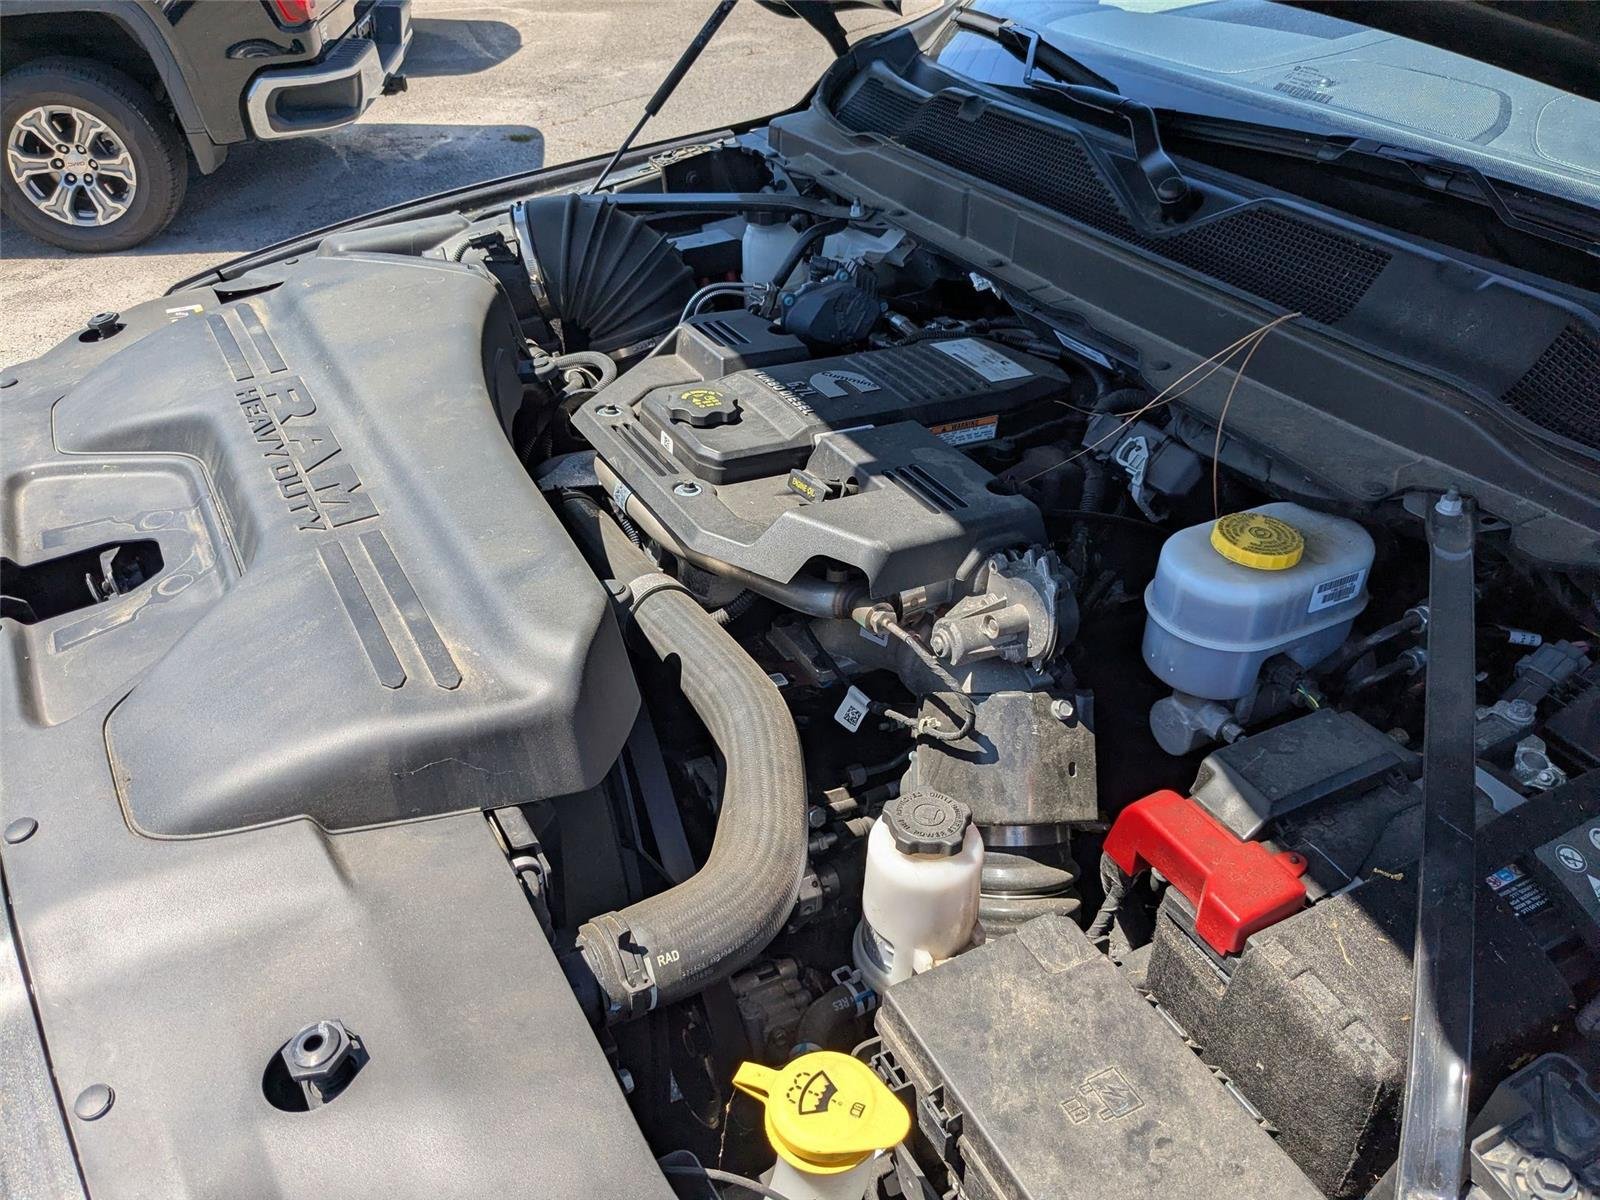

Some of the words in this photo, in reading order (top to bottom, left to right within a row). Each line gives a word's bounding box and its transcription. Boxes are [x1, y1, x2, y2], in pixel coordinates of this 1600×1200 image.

[754, 371, 786, 391] TURBO
[781, 390, 815, 416] DIESEL
[234, 387, 290, 457] HEAVY
[269, 458, 328, 531] DUTY
[260, 375, 380, 528] RAM
[656, 950, 681, 967] RAD
[832, 996, 850, 1012] RES
